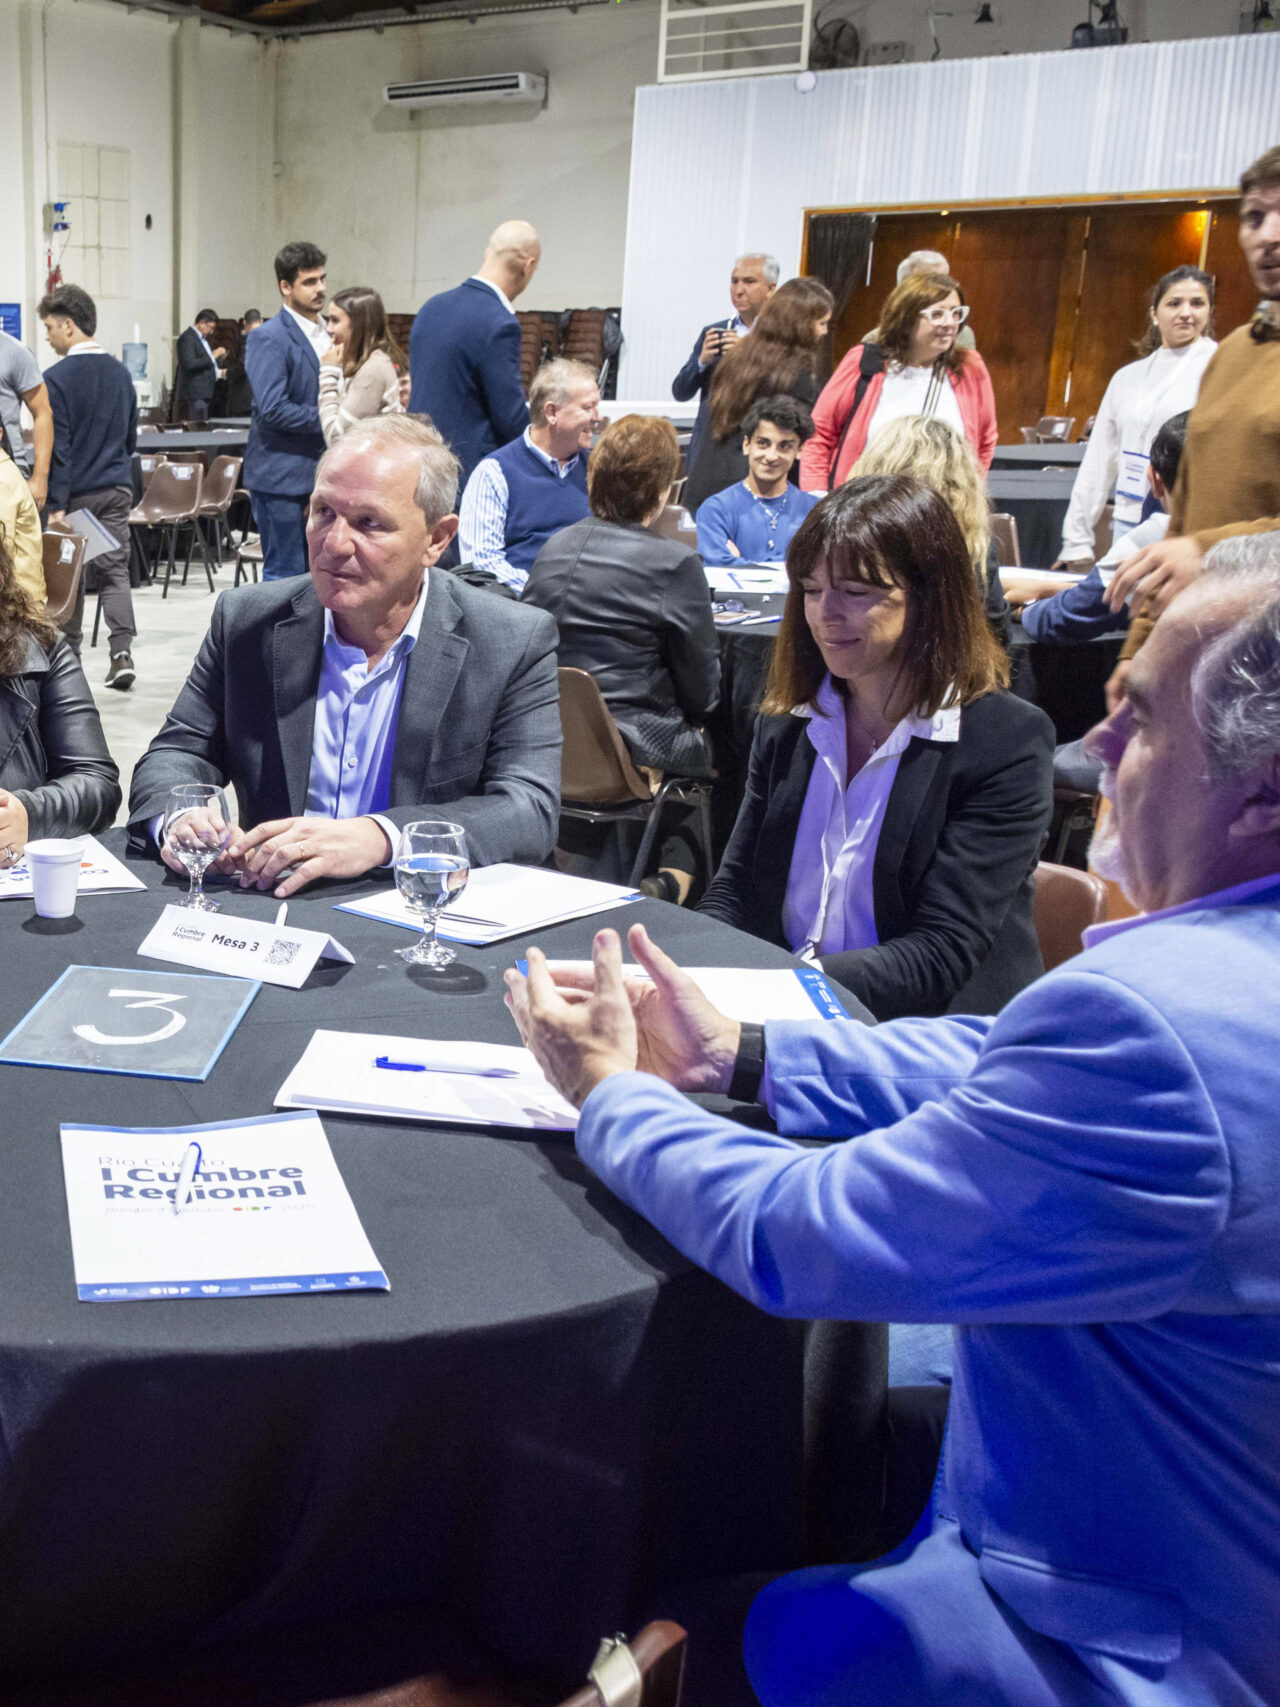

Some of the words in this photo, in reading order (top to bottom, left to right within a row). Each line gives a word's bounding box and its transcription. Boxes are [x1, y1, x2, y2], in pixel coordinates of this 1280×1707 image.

[211, 933, 247, 950] Mesa
[249, 941, 260, 952] 3
[73, 988, 188, 1046] 3
[144, 1157, 225, 1167] Cuto
[126, 1166, 304, 1183] Cumbre
